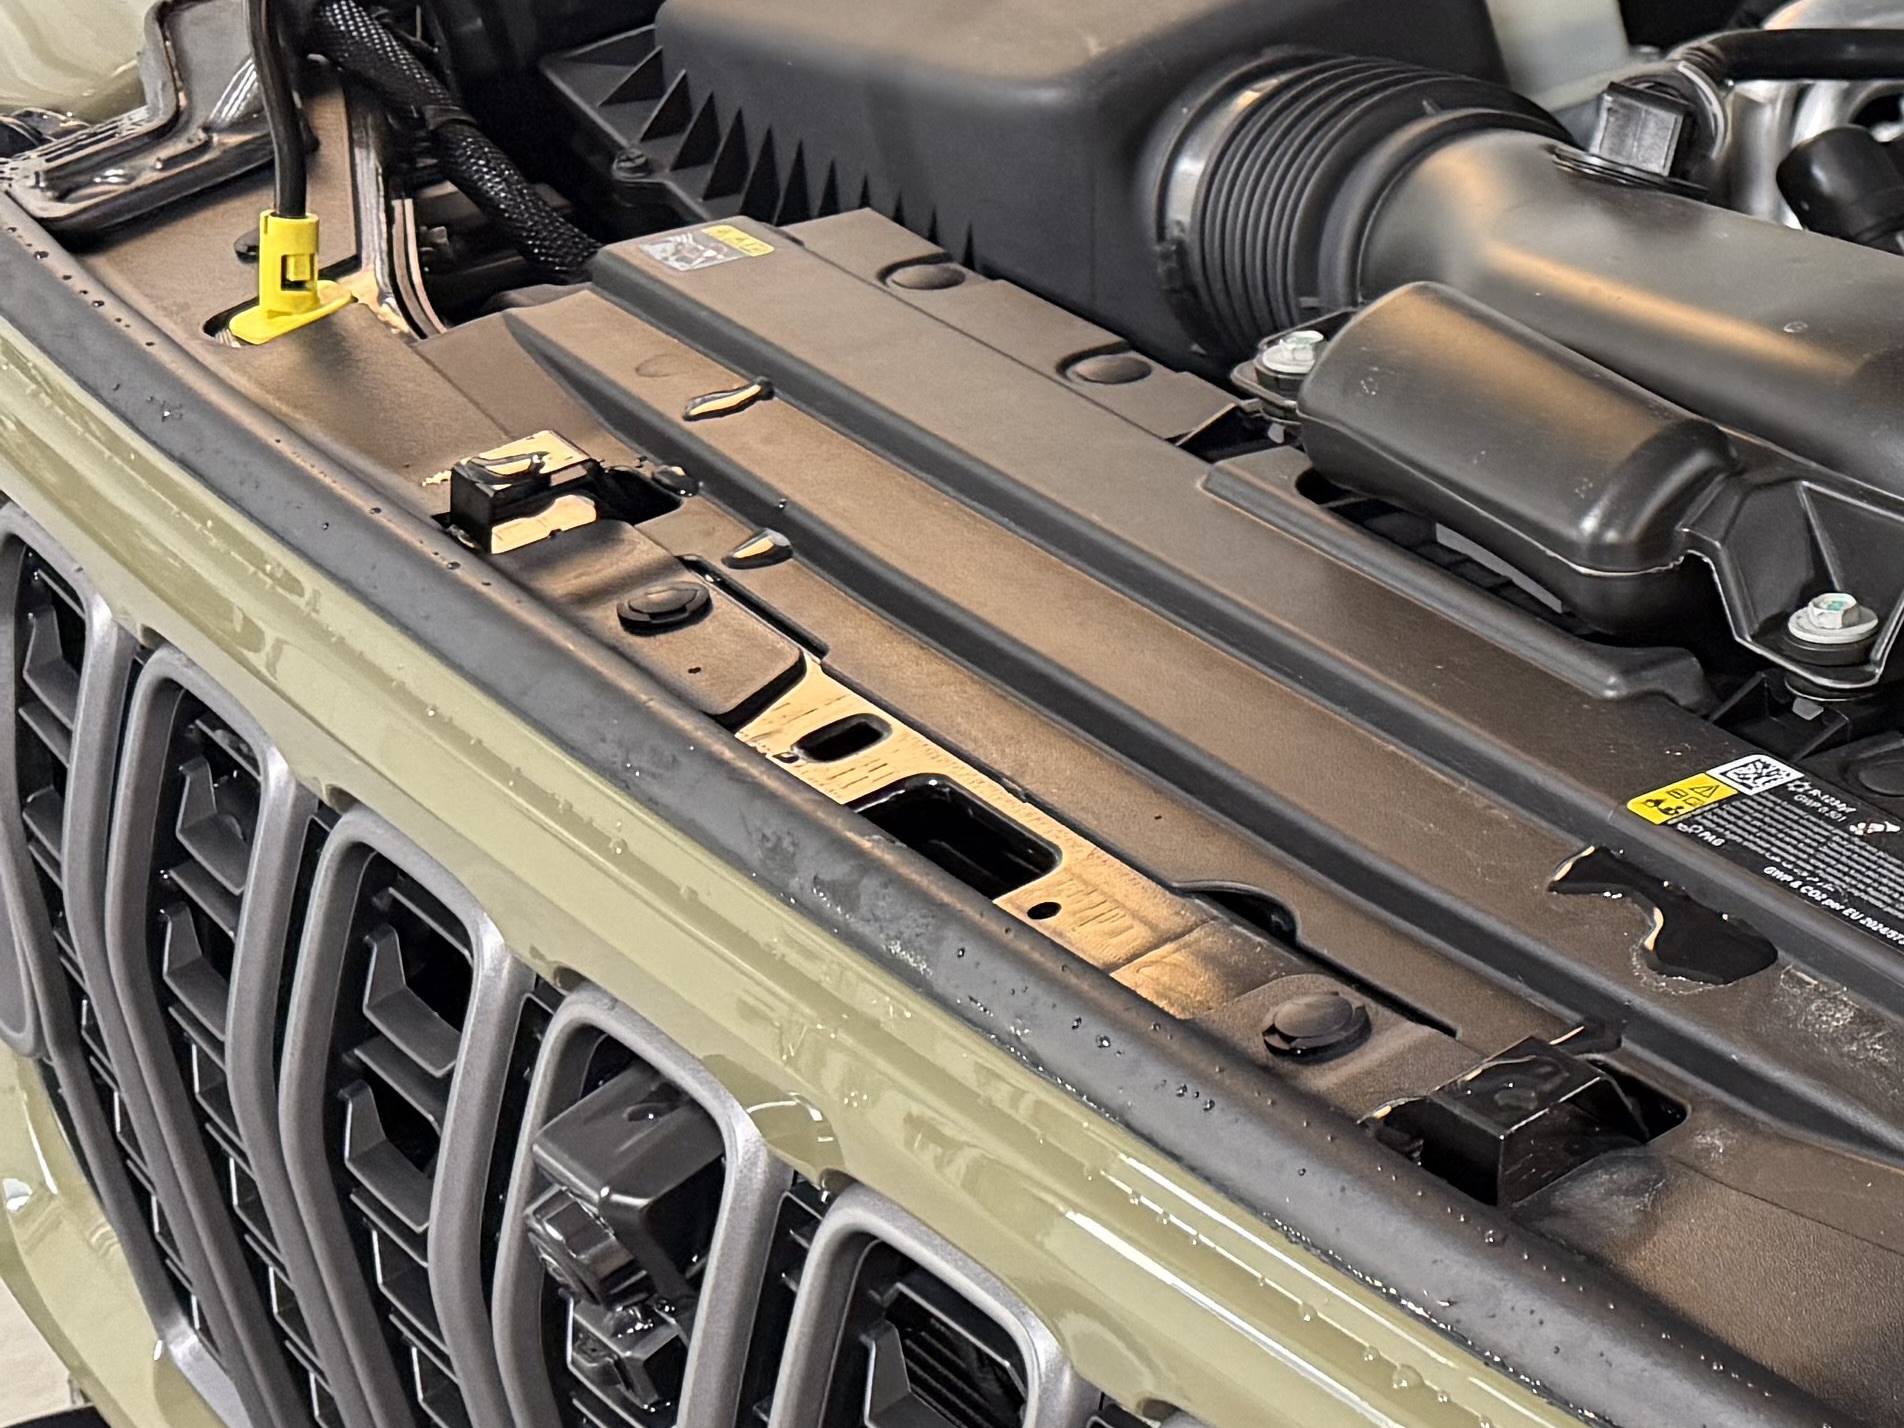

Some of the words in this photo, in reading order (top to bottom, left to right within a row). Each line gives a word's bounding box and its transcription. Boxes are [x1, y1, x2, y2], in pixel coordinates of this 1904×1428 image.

[1763, 866, 1794, 882] GWP
[1789, 880, 1803, 889] &
[1799, 884, 1828, 902] CO2
[1821, 898, 1846, 911] per
[1842, 907, 1865, 921] EU
